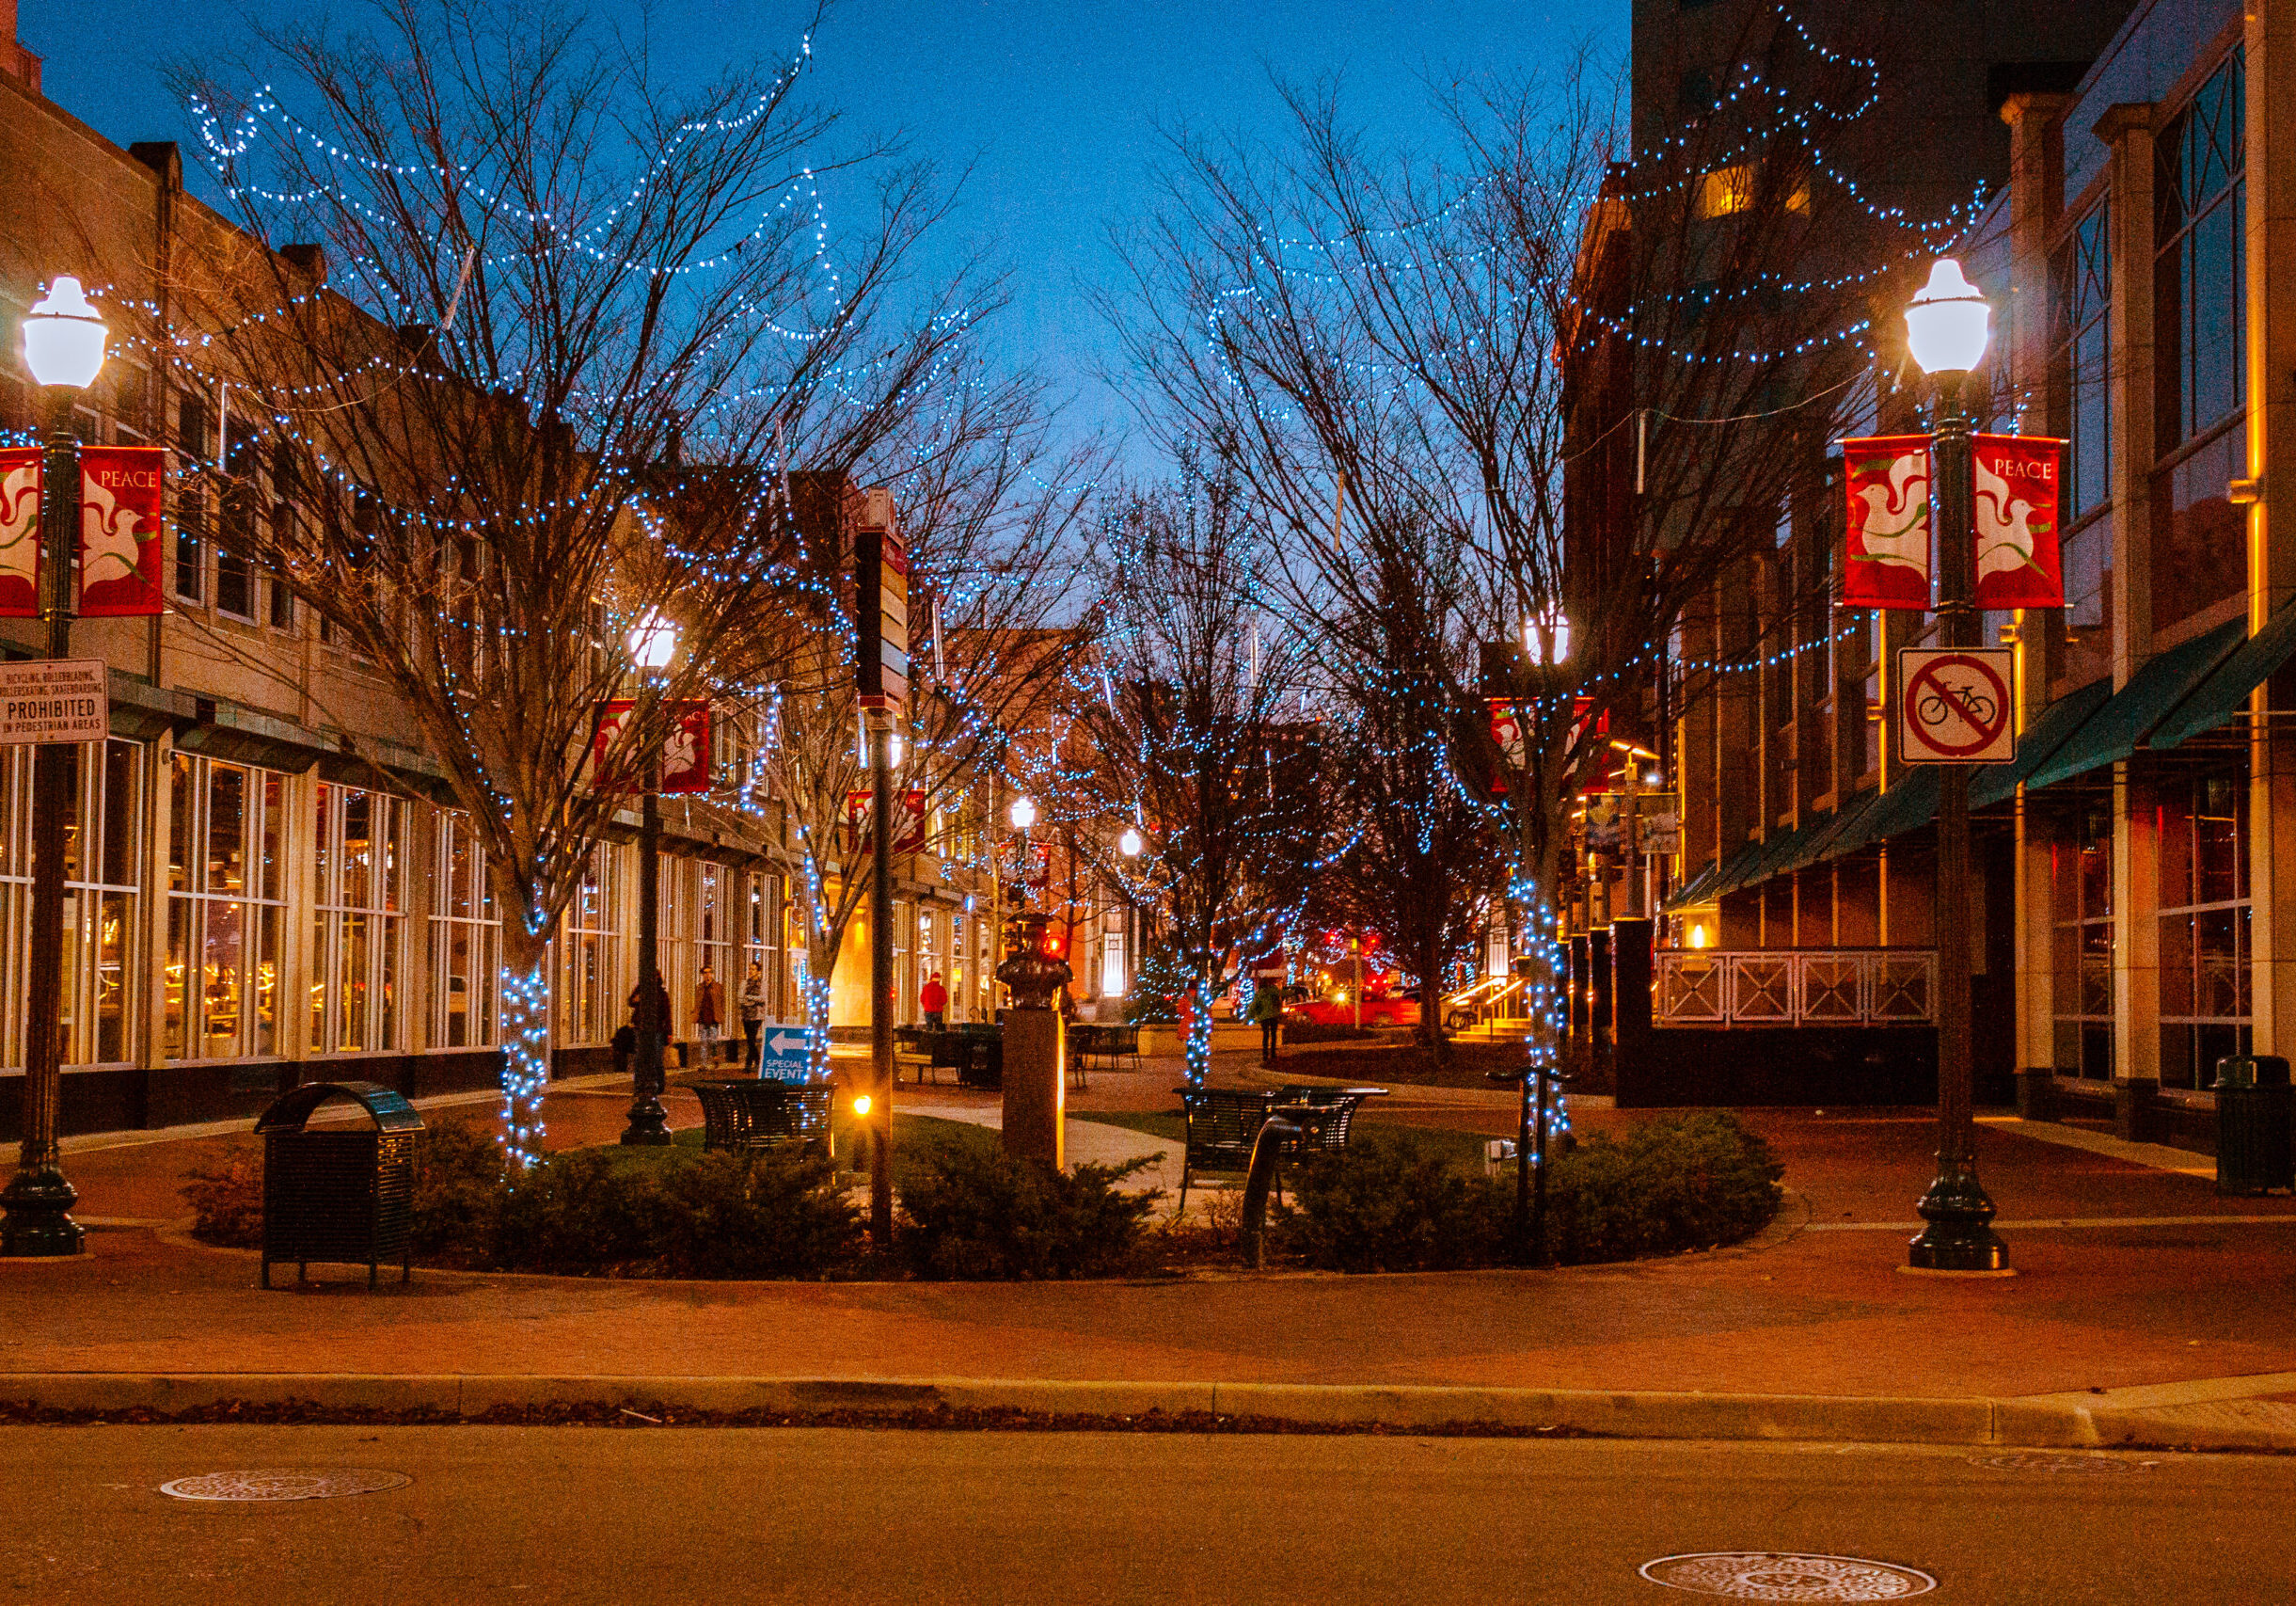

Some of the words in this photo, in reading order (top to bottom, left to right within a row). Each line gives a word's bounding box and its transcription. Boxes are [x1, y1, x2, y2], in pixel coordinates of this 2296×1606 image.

[1995, 458, 2052, 479] PEACE
[101, 470, 156, 487] PEACE
[8, 698, 95, 720] PROHIBITED
[3, 723, 12, 733] IN
[15, 720, 69, 733] PEDESTRIAN
[72, 718, 101, 730] AREAS
[767, 1058, 803, 1069] SPECIAL
[765, 1068, 804, 1079] EVENT
